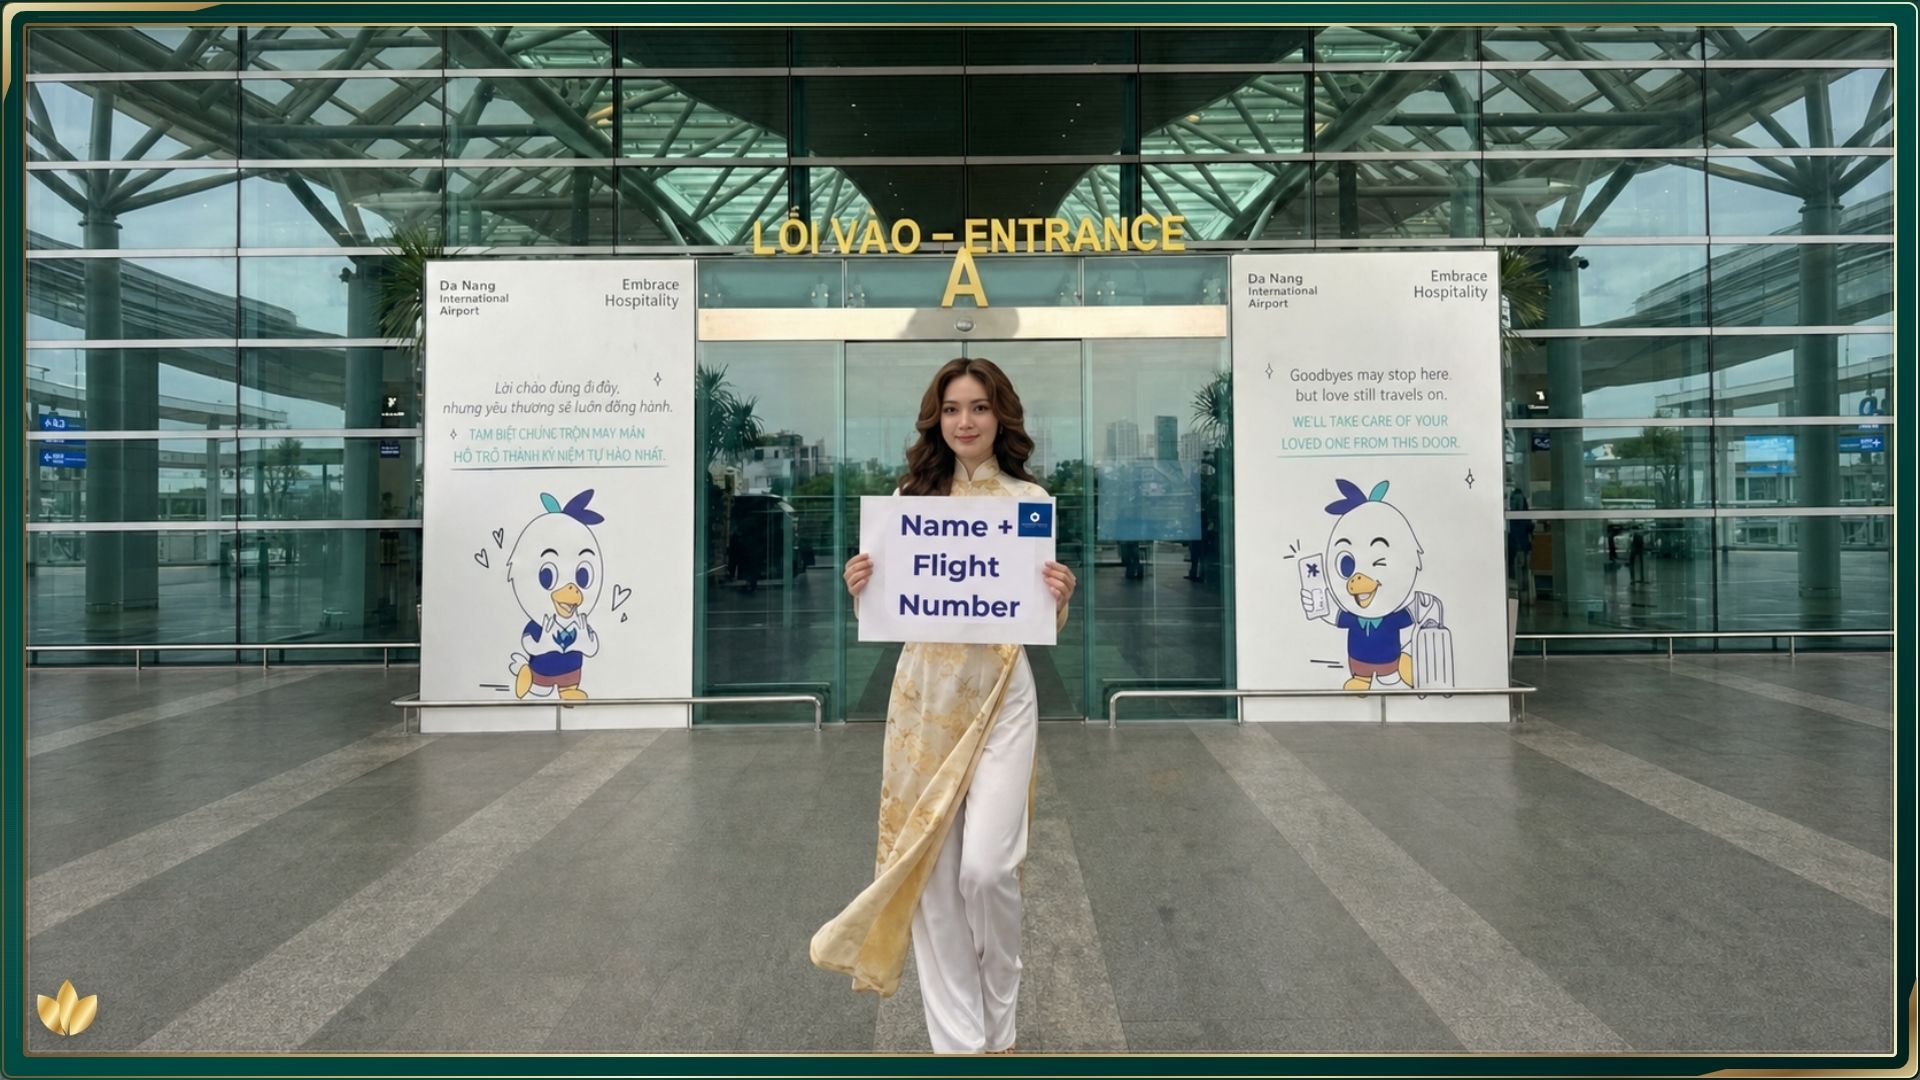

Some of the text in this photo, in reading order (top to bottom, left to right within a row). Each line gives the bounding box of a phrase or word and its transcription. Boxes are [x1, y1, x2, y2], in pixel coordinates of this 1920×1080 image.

[964, 214, 1186, 254] ENTRANCE
[940, 247, 989, 308] A
[1248, 273, 1303, 286] Da Nang
[1431, 270, 1488, 282] Embrace
[440, 280, 496, 293] Da Nang
[622, 278, 680, 291] Embrace
[1248, 286, 1318, 296] International
[440, 293, 510, 304] International
[1414, 285, 1488, 302] Hospitality
[605, 294, 680, 310] Hospitality
[1248, 299, 1289, 310] Airport
[440, 306, 480, 317] Airport
[1290, 368, 1353, 385] Goodbyes
[1357, 370, 1384, 384] may
[1388, 369, 1416, 384] stop
[1296, 388, 1448, 402] but love still travels on.
[511, 400, 555, 416] thương
[574, 400, 602, 414] luôn
[1329, 415, 1359, 428] TAKE
[1361, 415, 1393, 427] CARE
[1395, 415, 1412, 427] OF
[1415, 414, 1449, 427] YOUR
[592, 427, 617, 440] MAY
[1281, 436, 1461, 450] LOVED ONE FROM THIS DOOR.
[901, 514, 1013, 537] Name +
[913, 553, 1000, 583] Flight
[898, 594, 1021, 618] Number
